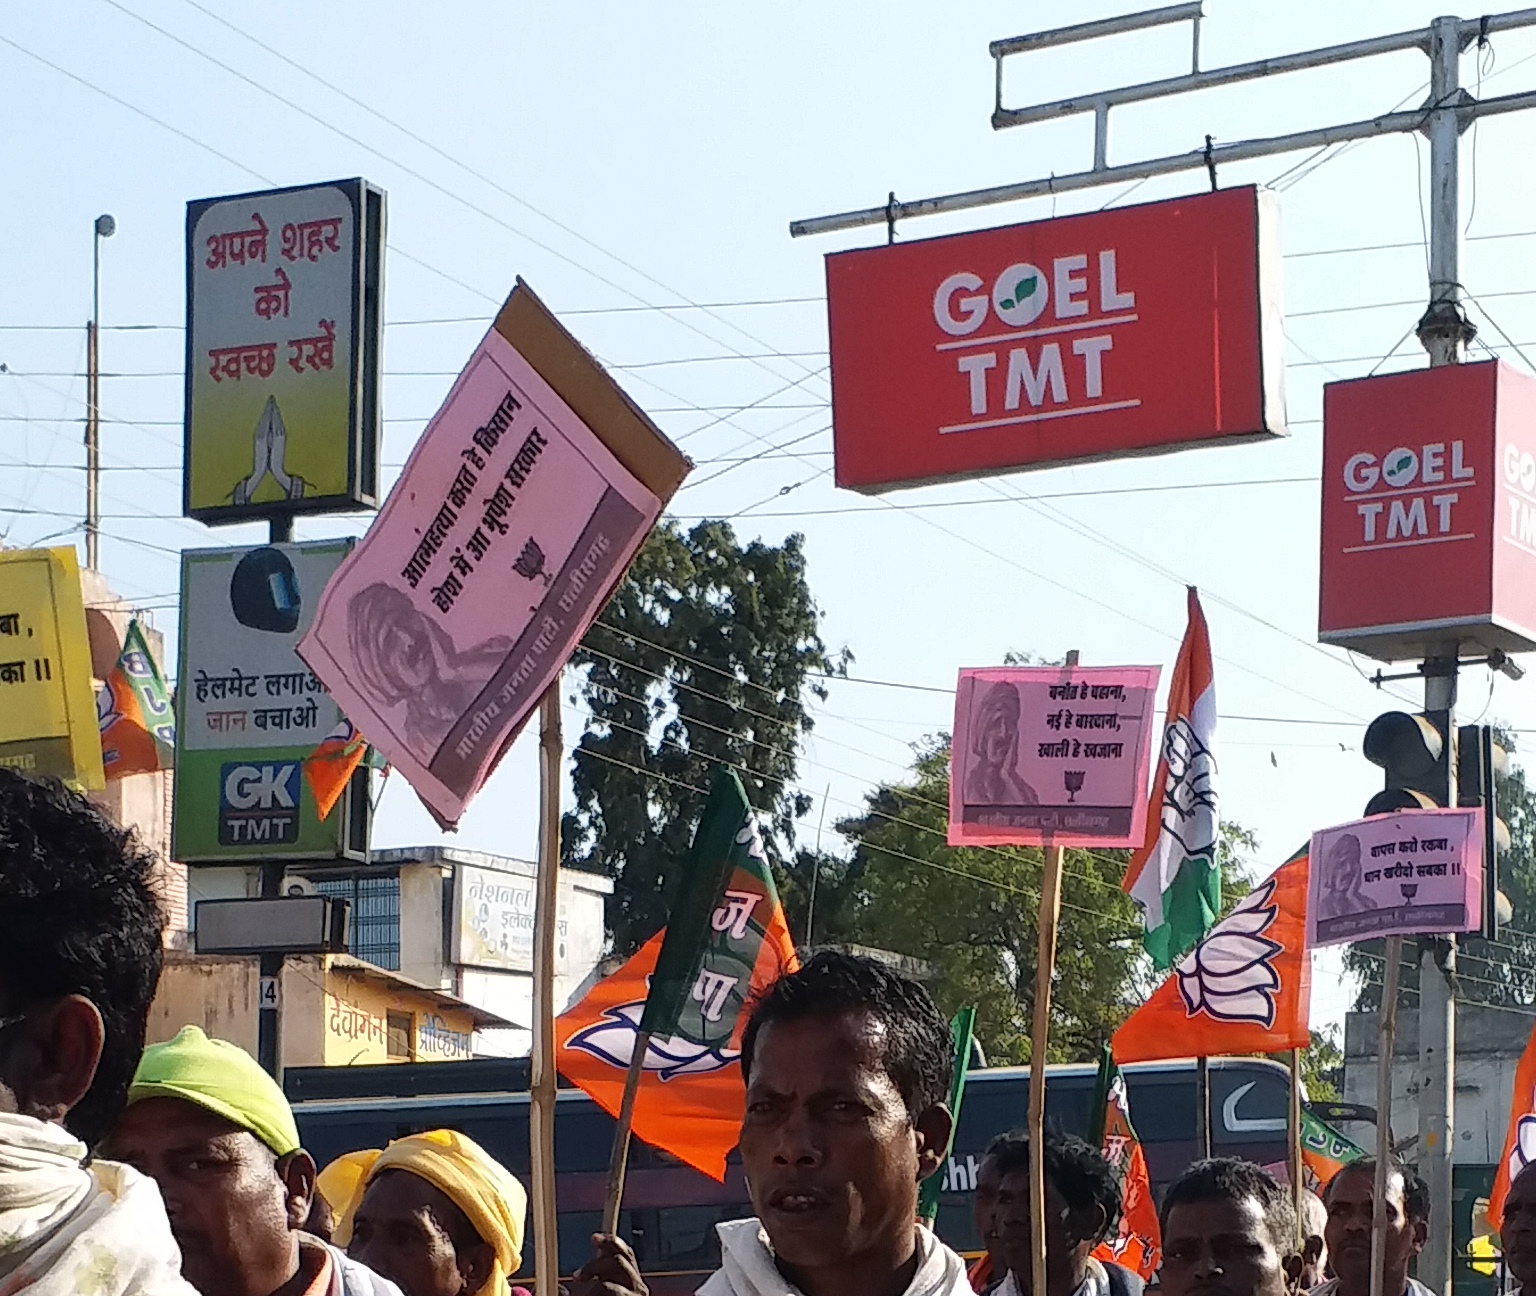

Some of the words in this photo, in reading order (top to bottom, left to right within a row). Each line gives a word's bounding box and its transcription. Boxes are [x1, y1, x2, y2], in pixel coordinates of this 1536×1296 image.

[206, 213, 269, 269] अपने
[282, 217, 342, 262] शहर
[253, 267, 292, 320] को
[934, 250, 1135, 336] GOEL
[209, 342, 277, 383] स्वच्छ
[288, 318, 336, 374] रखें
[958, 335, 1113, 416] TMT
[472, 390, 523, 457] किसान
[1344, 440, 1474, 492] GOEL
[430, 571, 464, 614] होश
[482, 481, 517, 536] भूपेश
[504, 426, 549, 489] सरकार
[1358, 493, 1458, 541] TMT
[194, 667, 259, 702] हेलमेट
[206, 709, 248, 733] जान
[253, 699, 318, 731] बचाओ
[1046, 709, 1063, 731] नई
[1037, 738, 1070, 759] खाली
[1083, 742, 1124, 760] खजाना
[225, 764, 296, 810] GK
[227, 817, 293, 843] TMT
[468, 875, 533, 908] नेशनल
